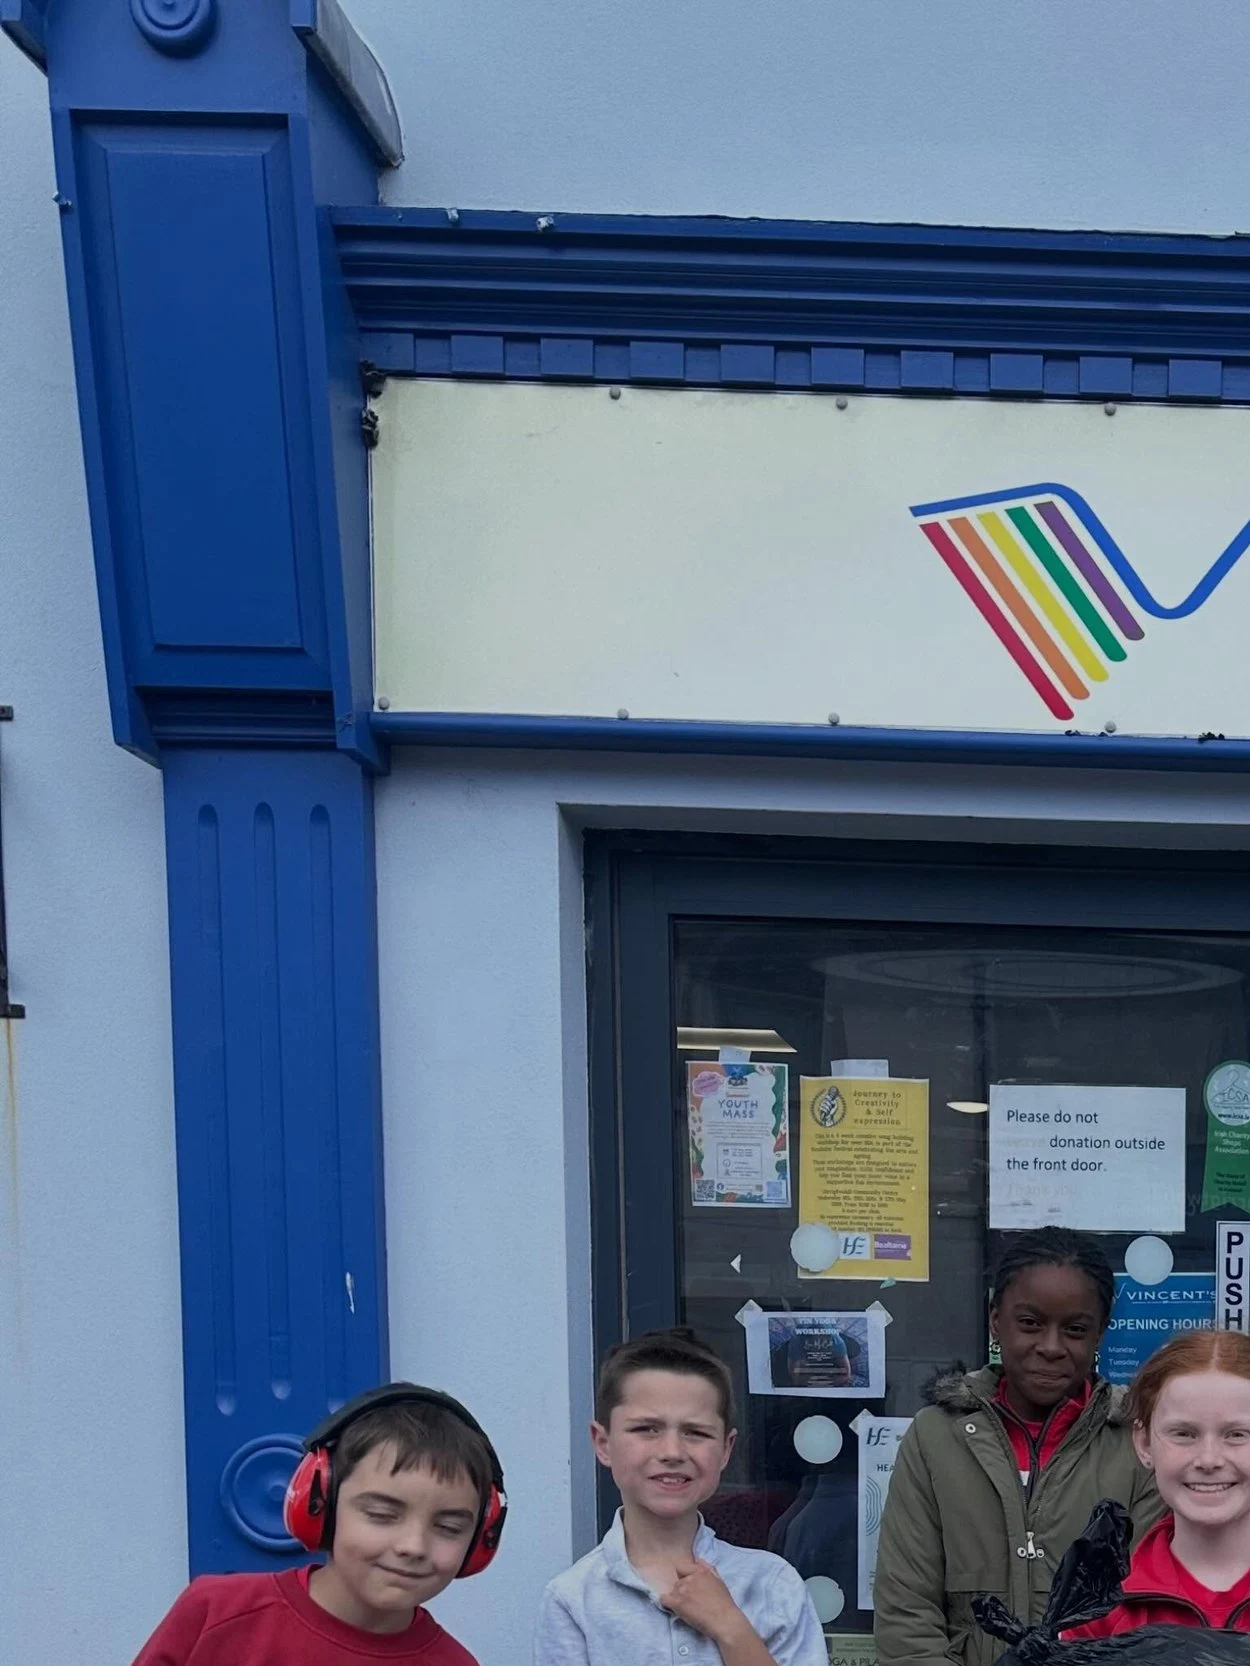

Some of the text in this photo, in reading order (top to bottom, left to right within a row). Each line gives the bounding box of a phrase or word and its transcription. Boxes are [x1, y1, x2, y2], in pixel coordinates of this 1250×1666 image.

[853, 1090, 888, 1099] Journey
[718, 1099, 758, 1109] YOUTH
[854, 1099, 900, 1108] Creativity
[723, 1109, 755, 1118] MASS
[876, 1108, 893, 1116] Self
[1007, 1110, 1099, 1124] Please do not
[854, 1118, 901, 1126] expression
[1050, 1135, 1111, 1149] donation
[1115, 1136, 1166, 1150] outside
[1006, 1158, 1107, 1171] the front door.
[1224, 1231, 1244, 1330] PUSH
[1108, 1318, 1169, 1330] OPENING
[1108, 1346, 1137, 1354] Monday
[1109, 1359, 1140, 1367] Tuesday
[830, 1656, 848, 1666] GA
